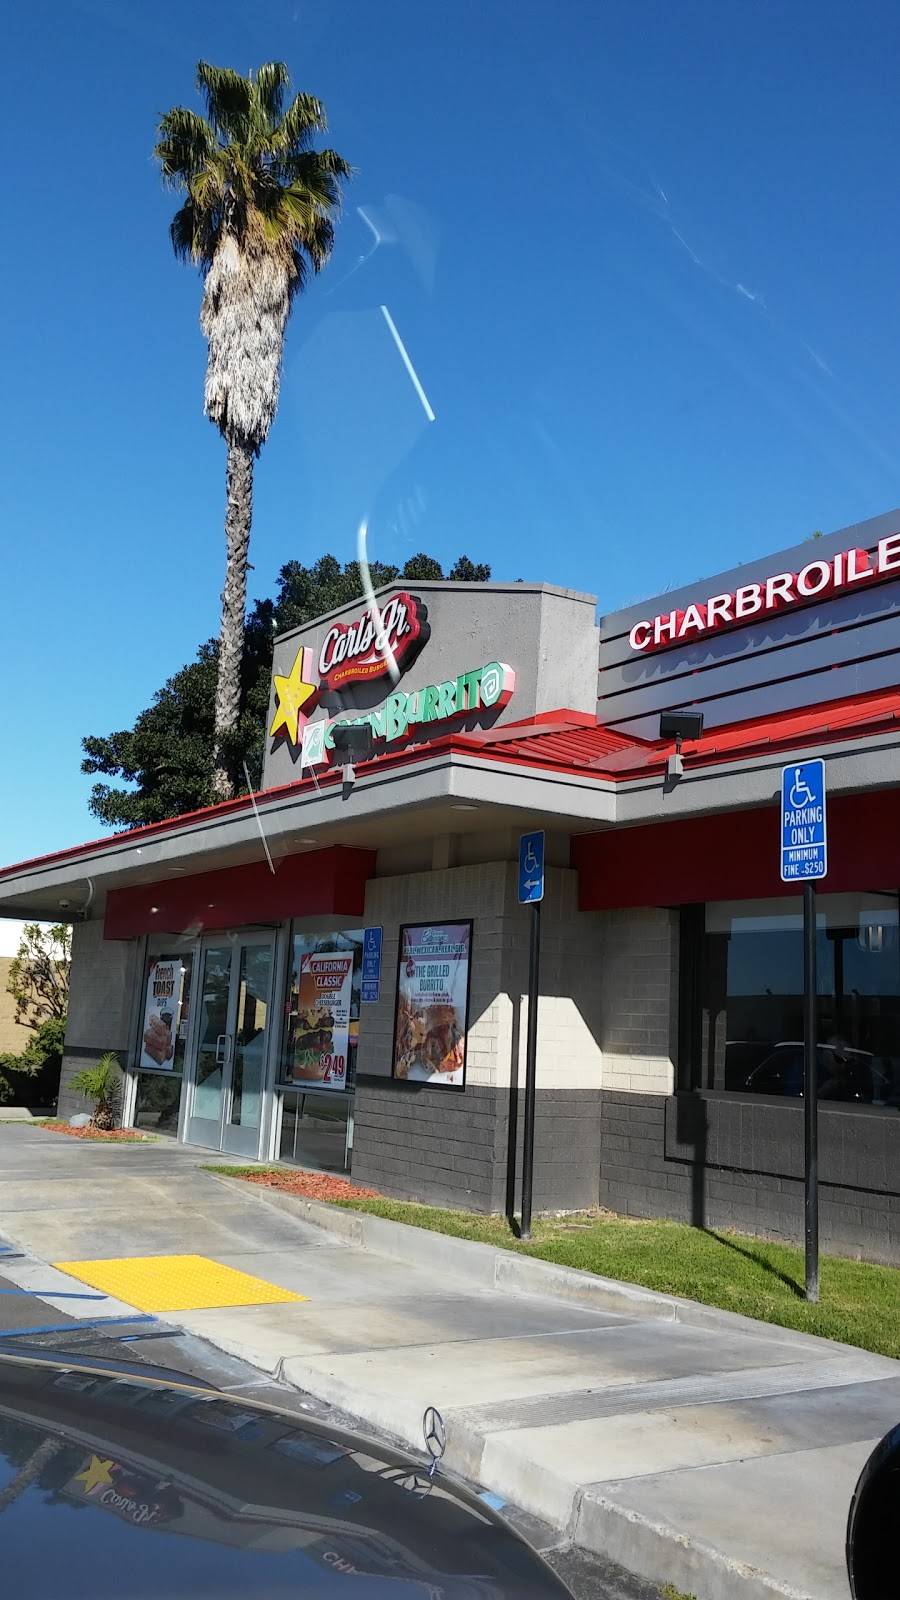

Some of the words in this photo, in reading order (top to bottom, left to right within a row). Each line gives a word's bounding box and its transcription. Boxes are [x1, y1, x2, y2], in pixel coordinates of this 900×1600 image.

[319, 612, 376, 674] Carl's
[375, 598, 411, 651] Jr.
[784, 806, 823, 827] PARKING
[791, 825, 816, 845] ONLY
[788, 847, 818, 862] MINIMUM
[784, 863, 800, 876] FINE
[312, 960, 349, 974] CALIFORNIA
[416, 965, 426, 978] THE
[427, 964, 450, 978] GRILLED
[316, 976, 343, 987] CLASSIC
[419, 979, 444, 992] BURRITO
[153, 981, 175, 998] TOAST
